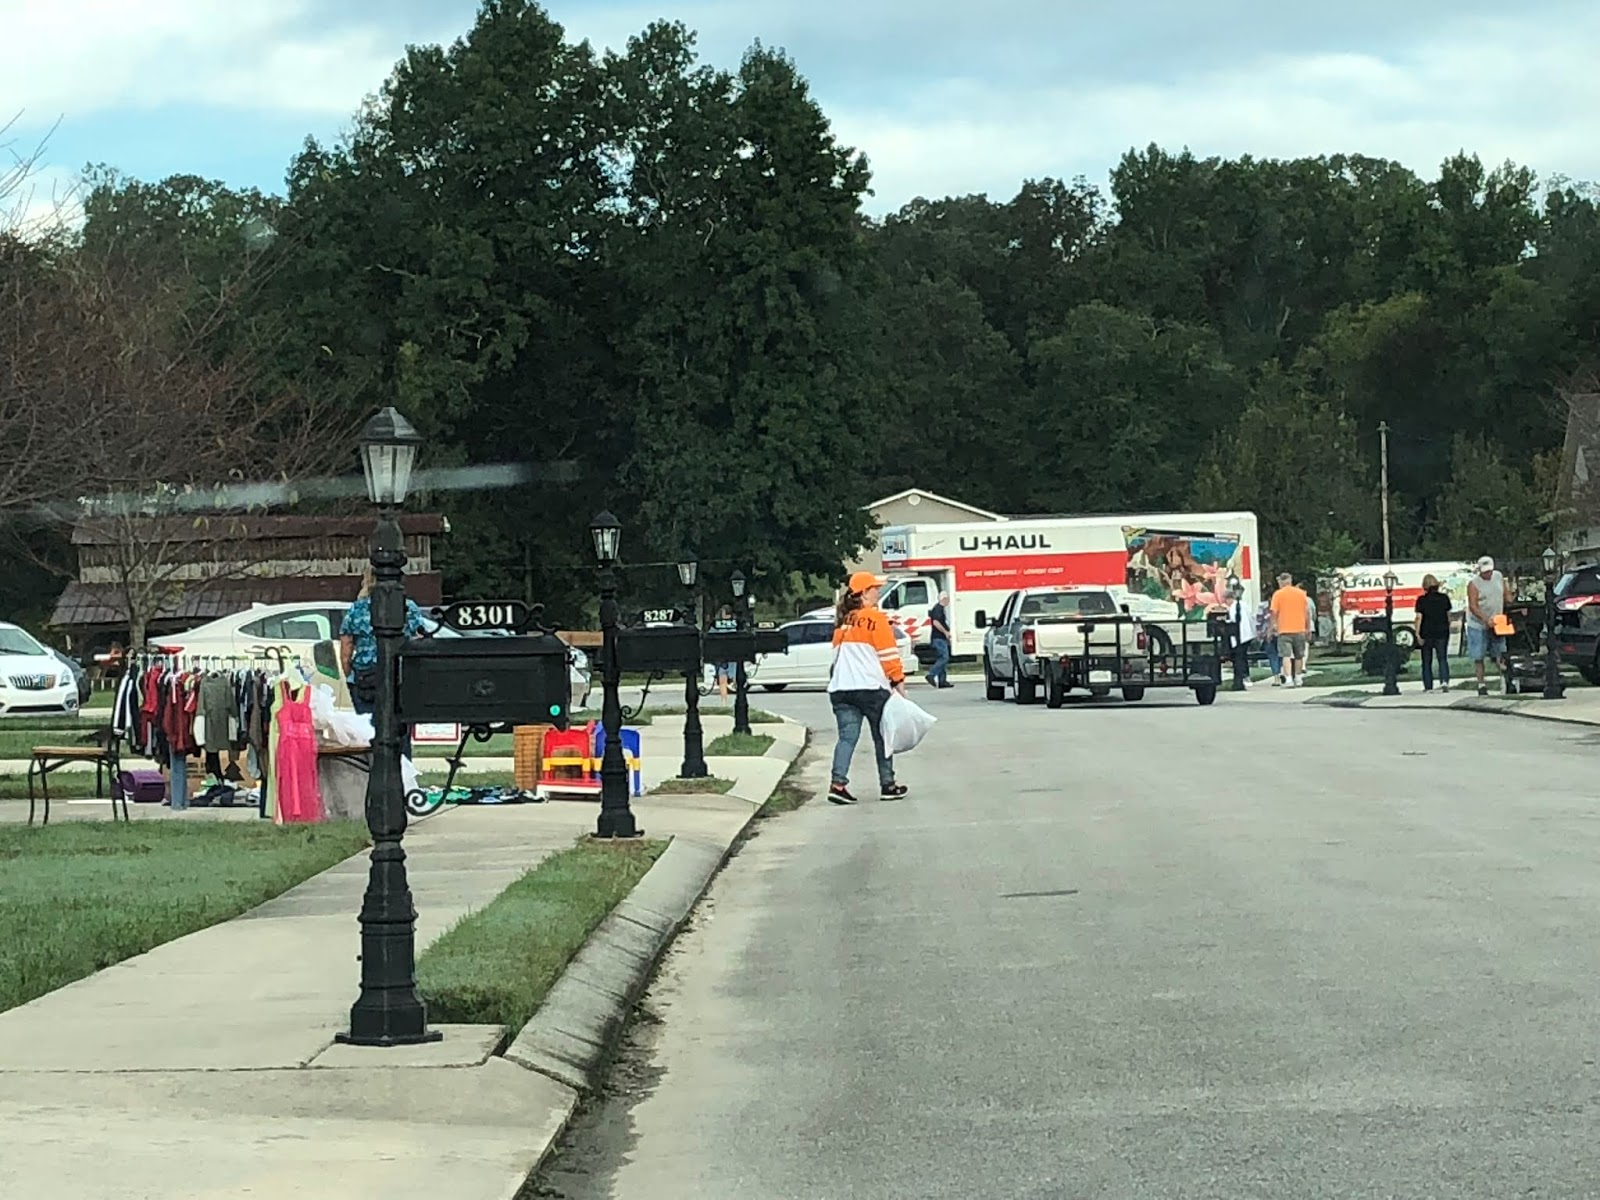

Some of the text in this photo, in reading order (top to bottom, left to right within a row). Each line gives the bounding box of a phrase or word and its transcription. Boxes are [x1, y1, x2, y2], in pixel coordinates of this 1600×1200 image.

[959, 534, 1051, 550] U-HAUL
[1344, 577, 1404, 588] U-HAL
[458, 605, 513, 625] 8301
[643, 609, 674, 621] 8287
